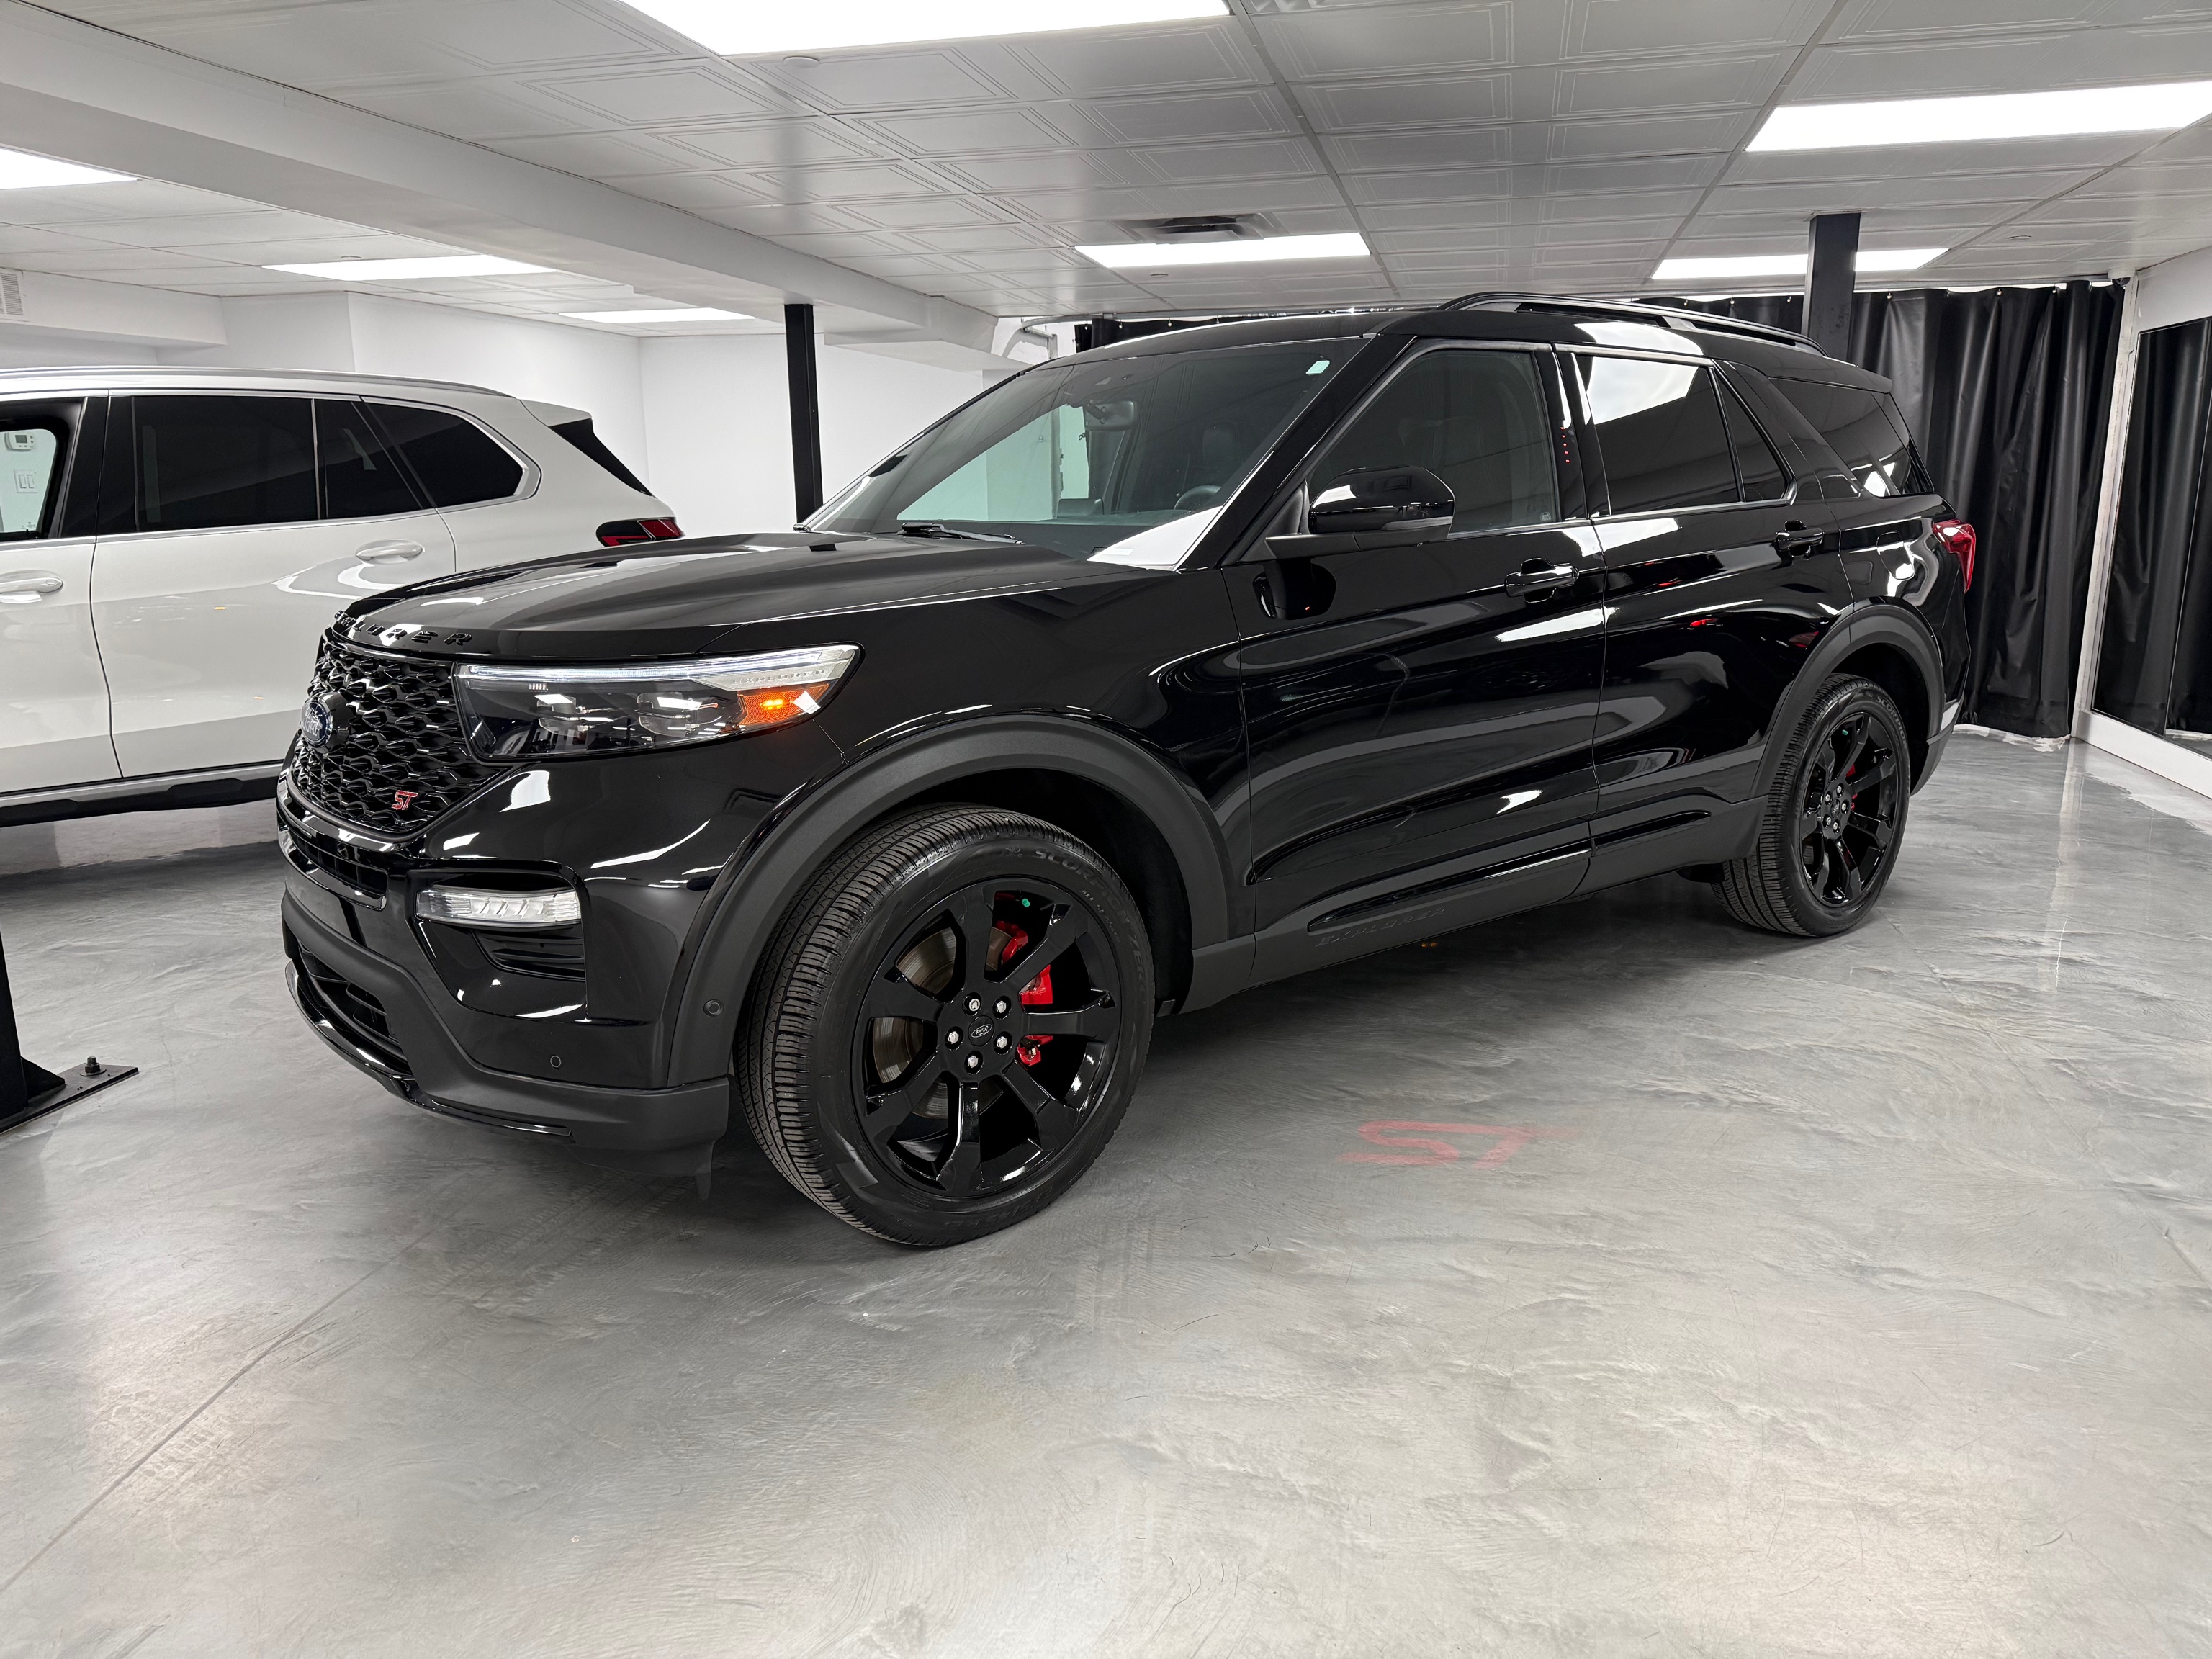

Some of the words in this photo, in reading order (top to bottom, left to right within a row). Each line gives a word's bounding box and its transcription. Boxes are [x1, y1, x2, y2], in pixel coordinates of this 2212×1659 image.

[734, 670, 825, 683] EXPLORER
[391, 789, 418, 811] ST
[1315, 908, 1446, 947] EXPLORER
